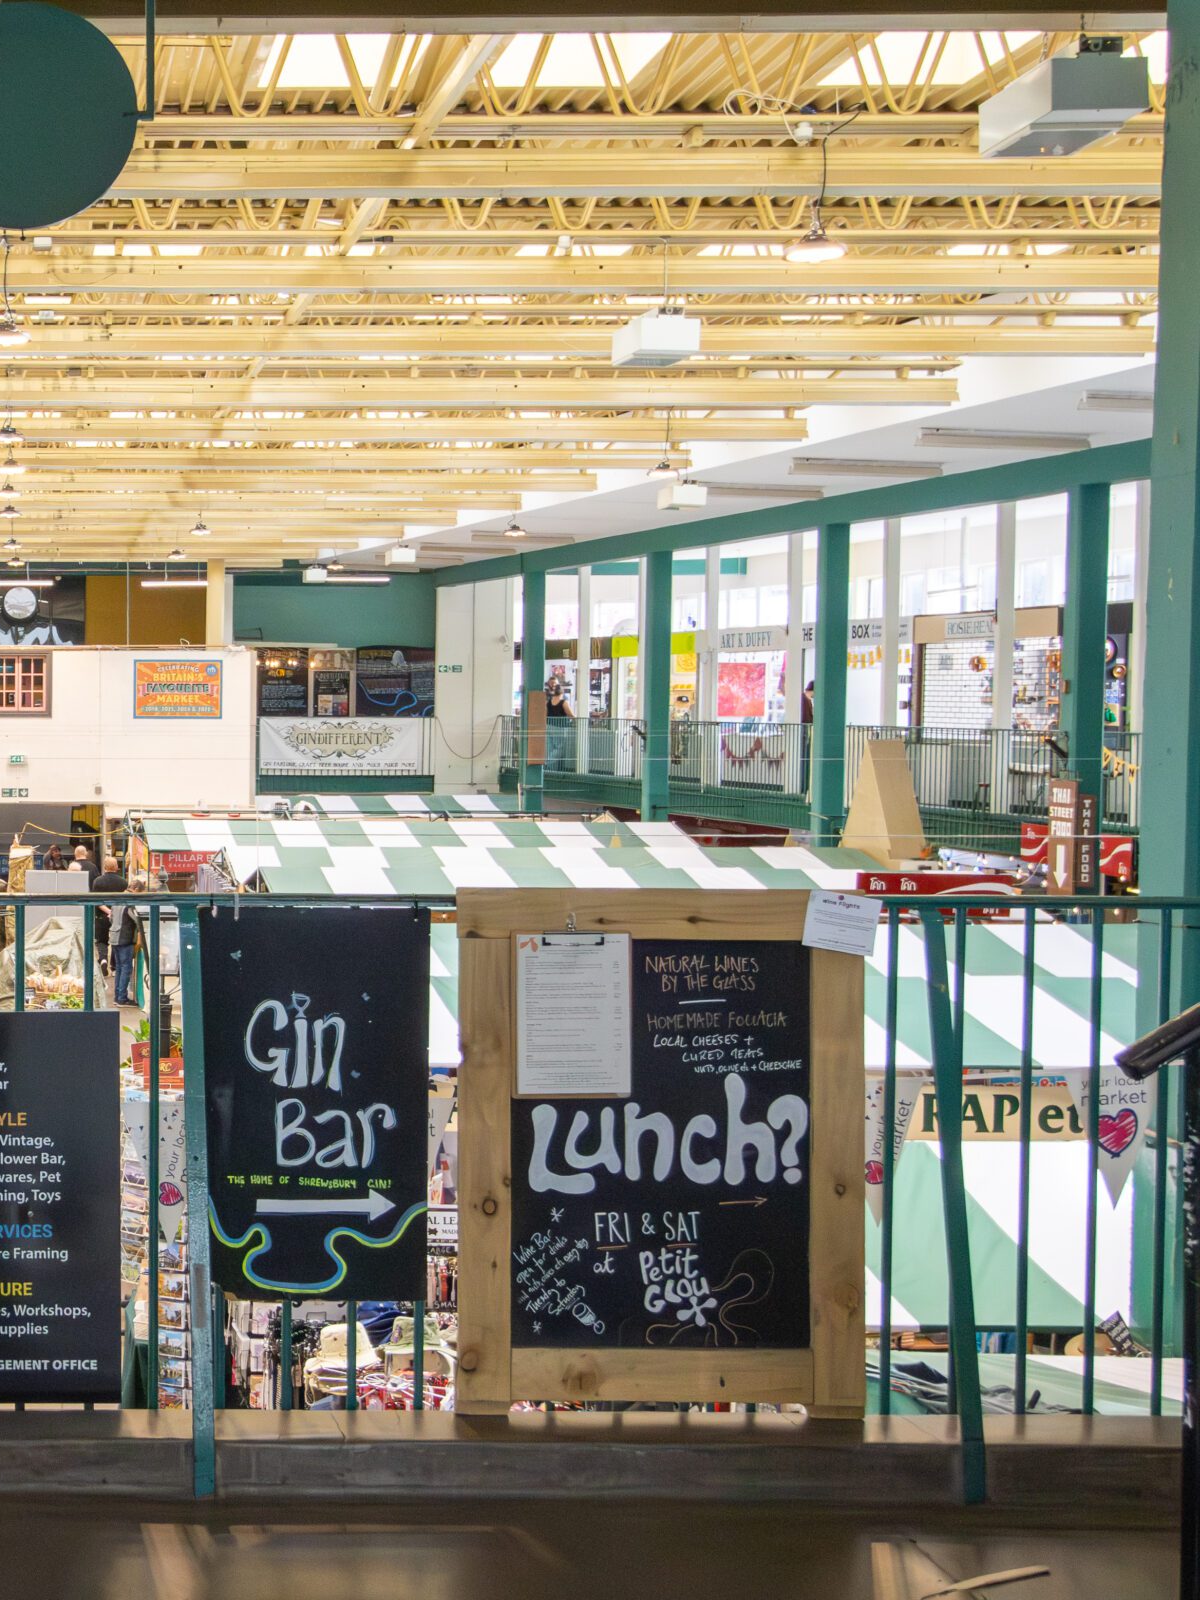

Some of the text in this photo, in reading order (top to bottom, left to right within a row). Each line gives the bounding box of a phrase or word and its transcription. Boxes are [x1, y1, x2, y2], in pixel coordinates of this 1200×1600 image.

[851, 624, 870, 639] BOX
[720, 631, 772, 648] ART K DUFFY
[153, 673, 204, 681] BRITAIN'S
[146, 684, 209, 692] FAVOURITE
[296, 732, 382, 746] GINDIFFERENT
[1053, 787, 1071, 804] THAI
[1050, 806, 1073, 819] STREET
[1051, 820, 1072, 836] FOOD
[1081, 799, 1092, 882] THAI FOOD
[168, 854, 203, 862] PILLAR
[645, 955, 759, 973] NATURAL WINES
[661, 973, 756, 993] BY THE GLASS
[647, 1013, 722, 1032] HOMEMADE
[244, 993, 347, 1096] Gin
[654, 1034, 739, 1047] LOCAL CHEESES
[682, 1050, 724, 1062] CURED
[275, 1098, 397, 1169] Bar
[528, 1073, 809, 1195] Lunch?
[0, 1134, 54, 1149] Vintage,
[41, 1154, 66, 1166] Bar,
[166, 1151, 179, 1178] your
[39, 1171, 61, 1183] Pet
[227, 1175, 392, 1189] THE HOME OF SHREWSBURY GIN!
[31, 1189, 61, 1203] Toys
[594, 1211, 701, 1243] FRI & SAT
[513, 1229, 551, 1264] Wine Bar
[13, 1247, 69, 1262] Framing
[593, 1252, 615, 1274] at
[639, 1248, 698, 1285] Petit
[13, 1304, 92, 1319] Workshops,
[52, 1360, 97, 1371] OFFICE
